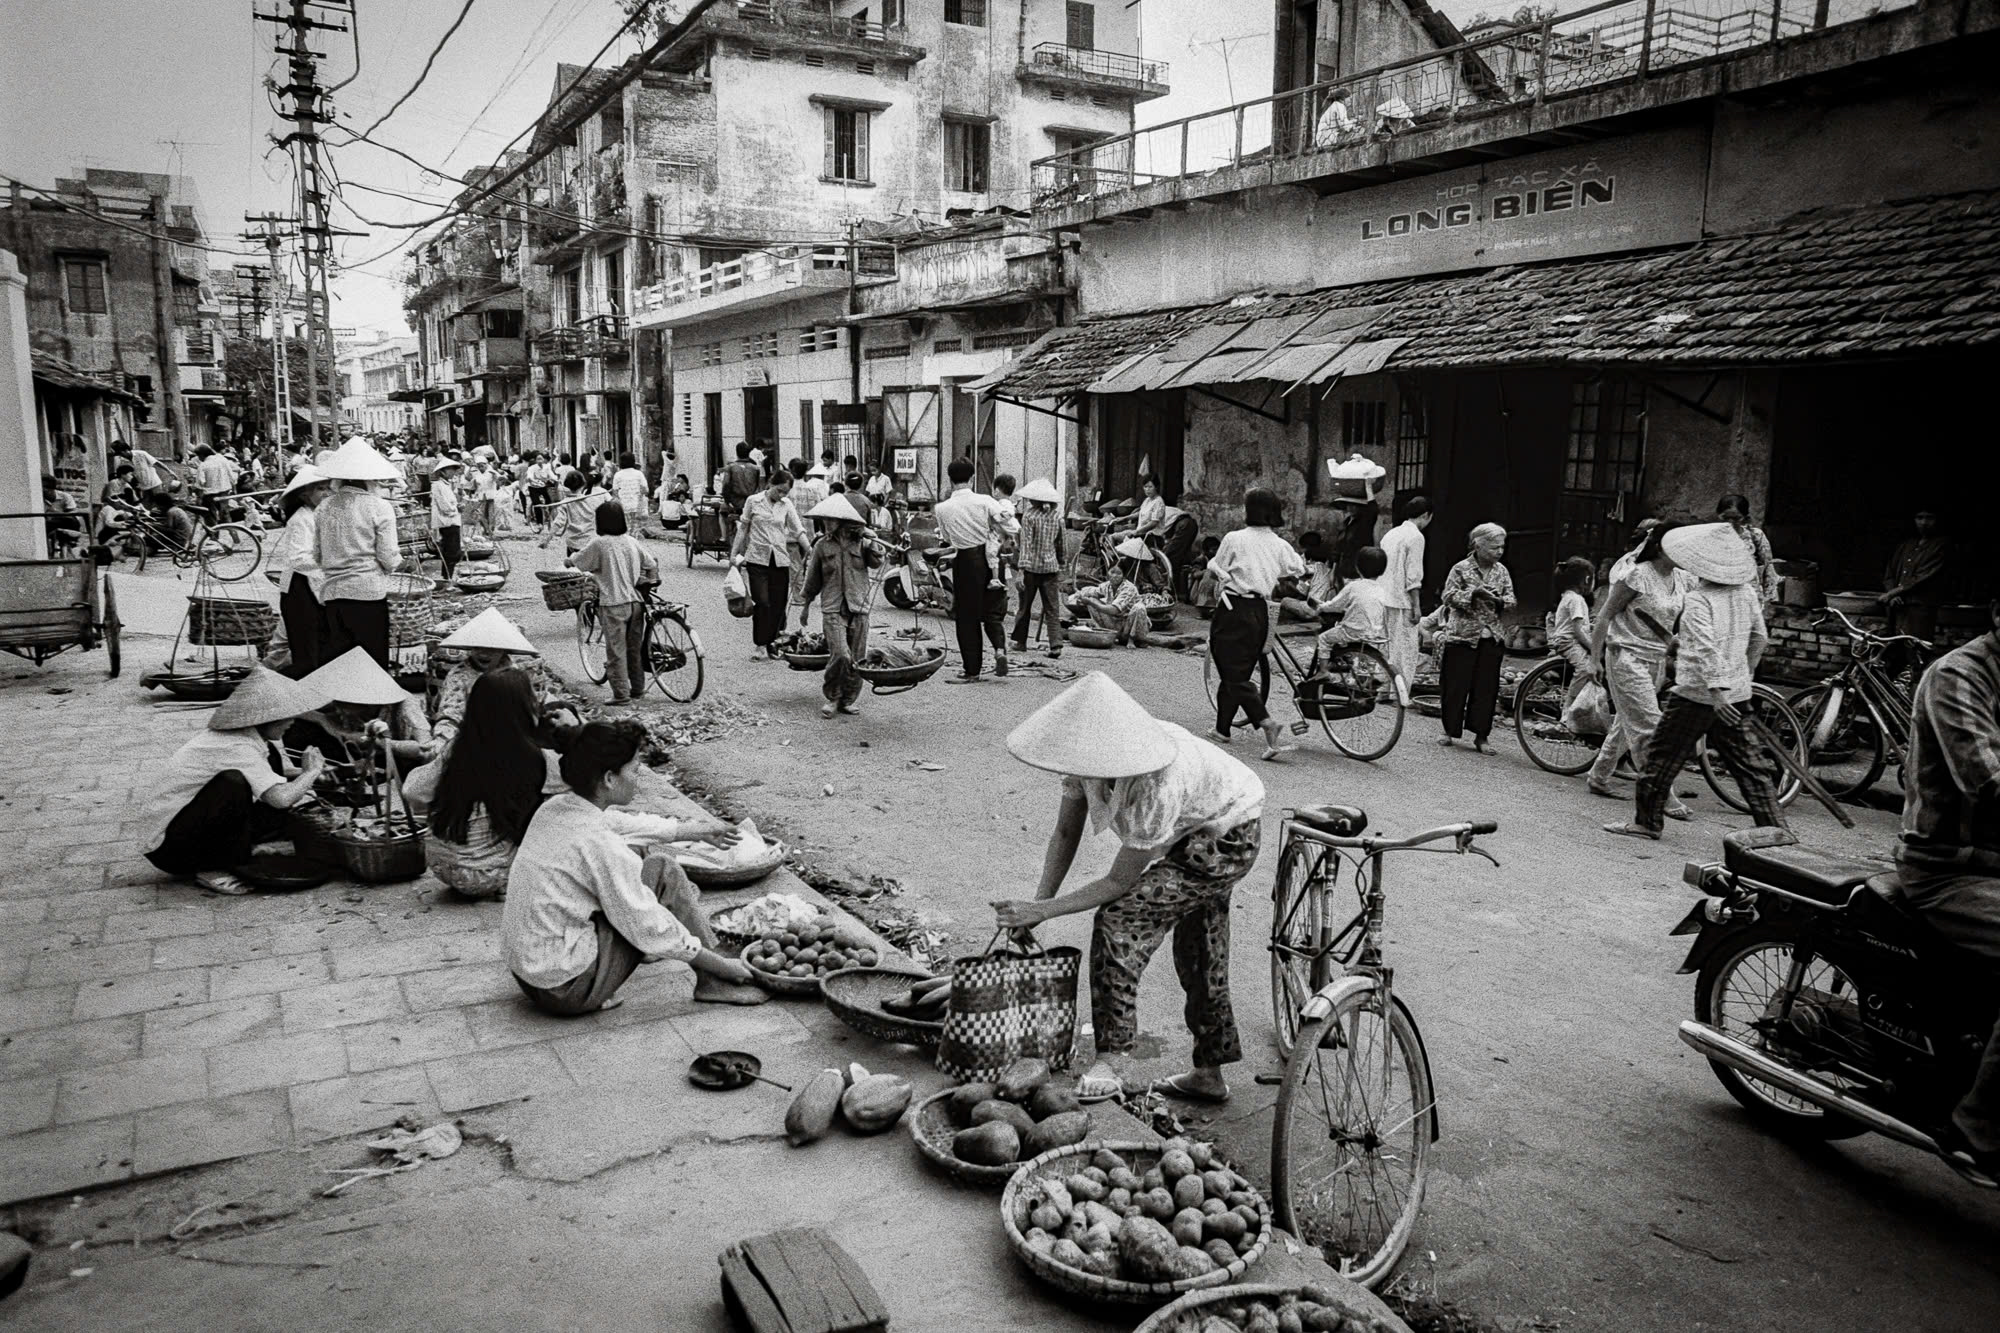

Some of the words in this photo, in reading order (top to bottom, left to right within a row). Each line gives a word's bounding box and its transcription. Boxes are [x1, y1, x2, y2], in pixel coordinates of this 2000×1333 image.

[1361, 202, 1472, 242] LONG
[1492, 175, 1616, 222] BIÊN
[1866, 937, 1908, 956] HONDA
